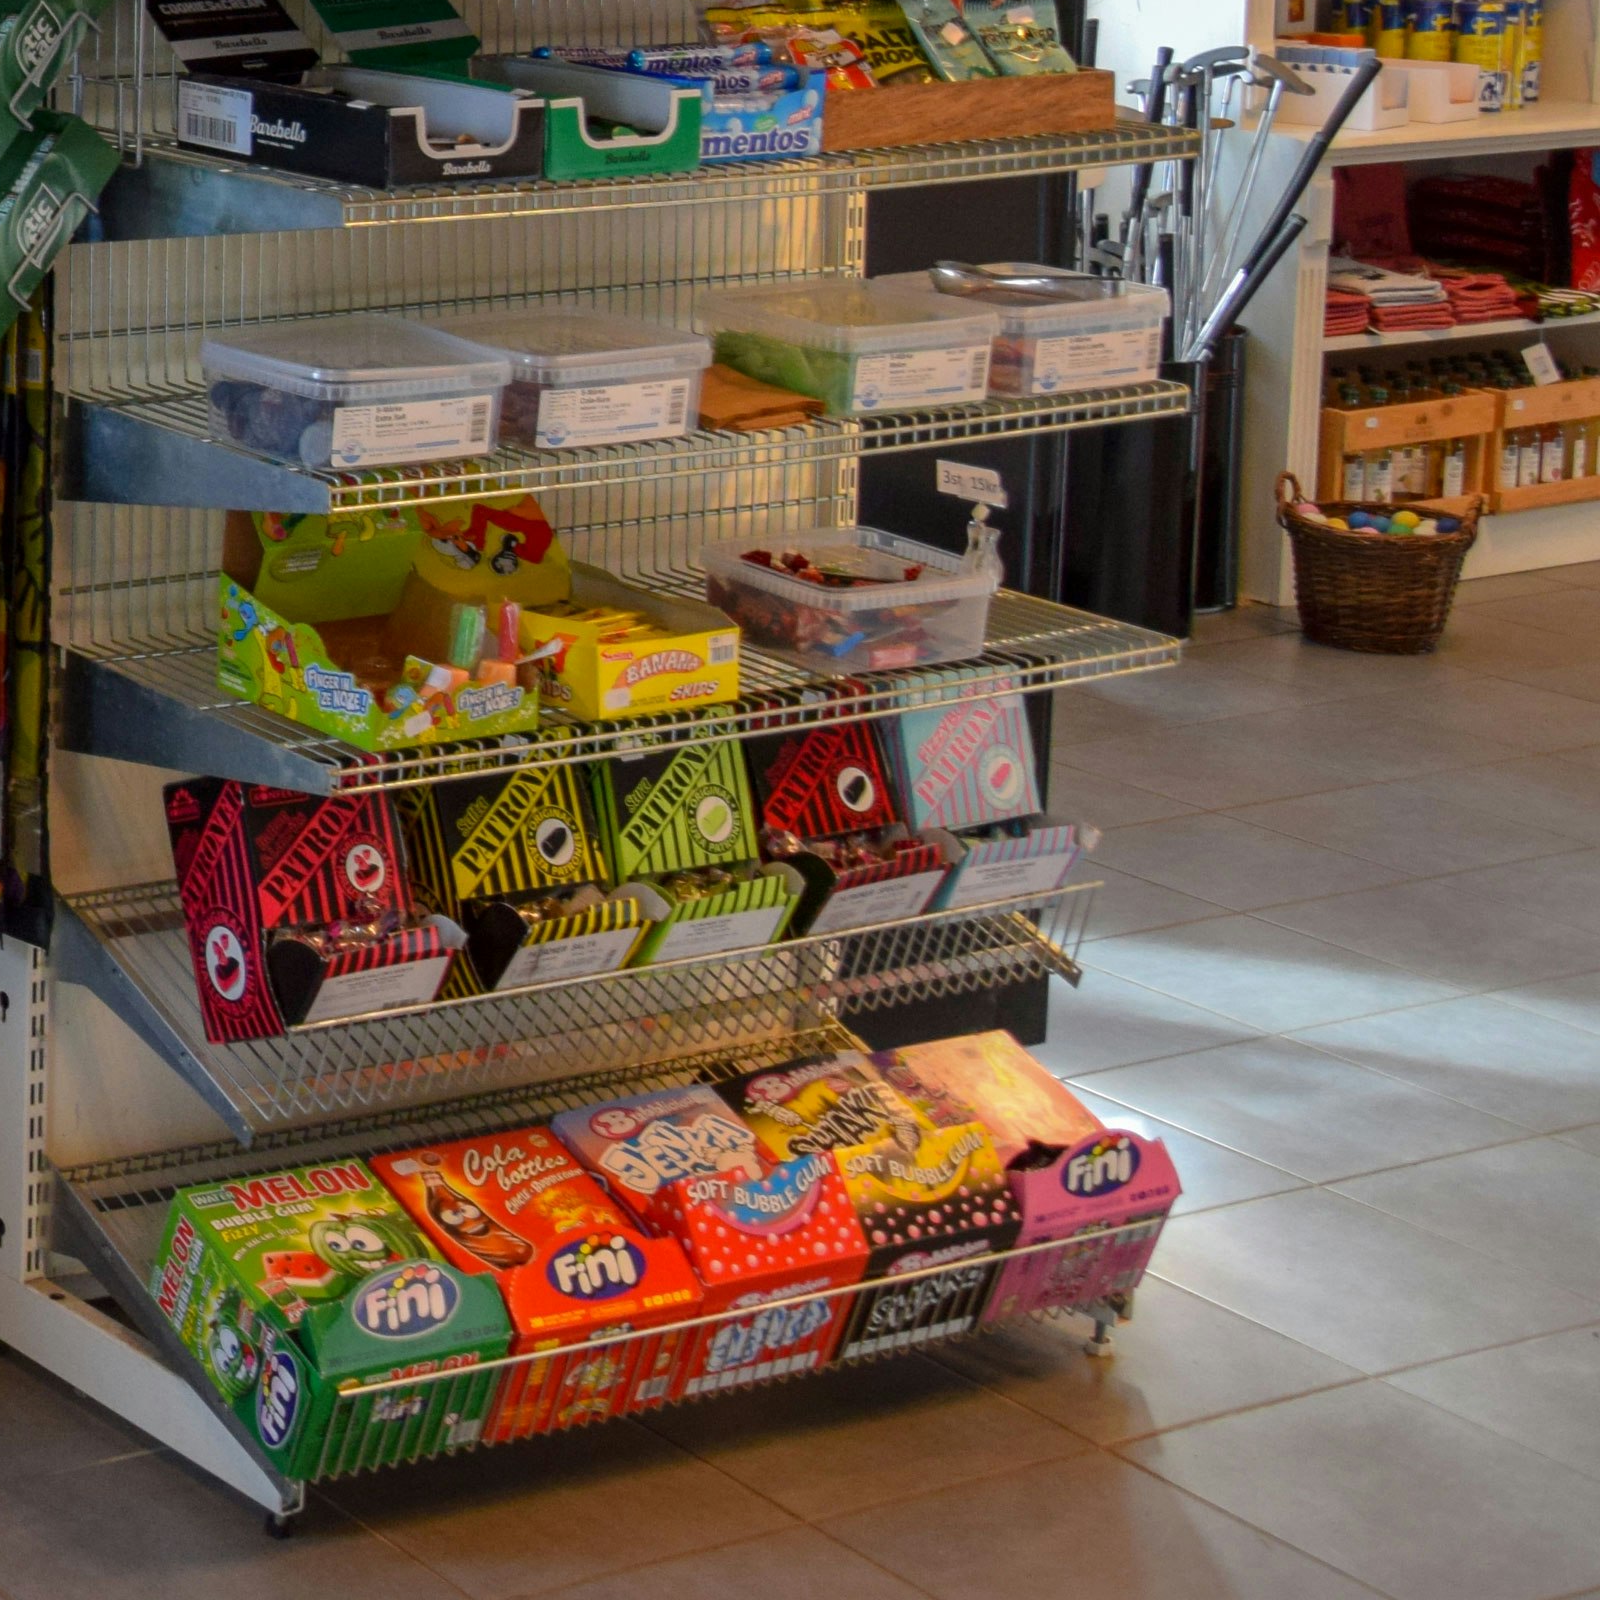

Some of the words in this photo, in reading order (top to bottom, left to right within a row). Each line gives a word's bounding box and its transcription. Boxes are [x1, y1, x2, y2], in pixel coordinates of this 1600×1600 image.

[24, 16, 50, 50] tic
[213, 36, 268, 51] Barebells
[378, 25, 432, 41] Barebells
[648, 52, 723, 72] mentos
[249, 113, 306, 143] Barebells
[702, 125, 810, 158] mentos
[442, 160, 493, 176] Barebells
[25, 198, 51, 232] tic
[306, 667, 339, 689] FINGER
[626, 651, 704, 684] BANANA
[670, 679, 718, 701] SKIDS
[624, 740, 720, 852] PATRON
[459, 766, 556, 878] PATRON
[463, 1138, 526, 1186] Cola
[497, 1153, 568, 1192] bottles
[844, 1153, 883, 1179] SOFT
[888, 1158, 951, 1187] BUBBLE
[949, 1130, 984, 1166] GUM
[1068, 1137, 1132, 1195] Fini
[225, 1163, 371, 1212] MELON
[686, 1178, 729, 1206] SOFT
[733, 1187, 797, 1213] BUBBLE
[795, 1150, 832, 1192] GUM
[211, 1206, 274, 1232] BUBBLE
[275, 1201, 315, 1219] GUM
[221, 1224, 259, 1243] Fizzy
[158, 1216, 195, 1318] MELON
[554, 1237, 638, 1295] Fini
[365, 1269, 446, 1331] Fini
[260, 1357, 298, 1444] Fini
